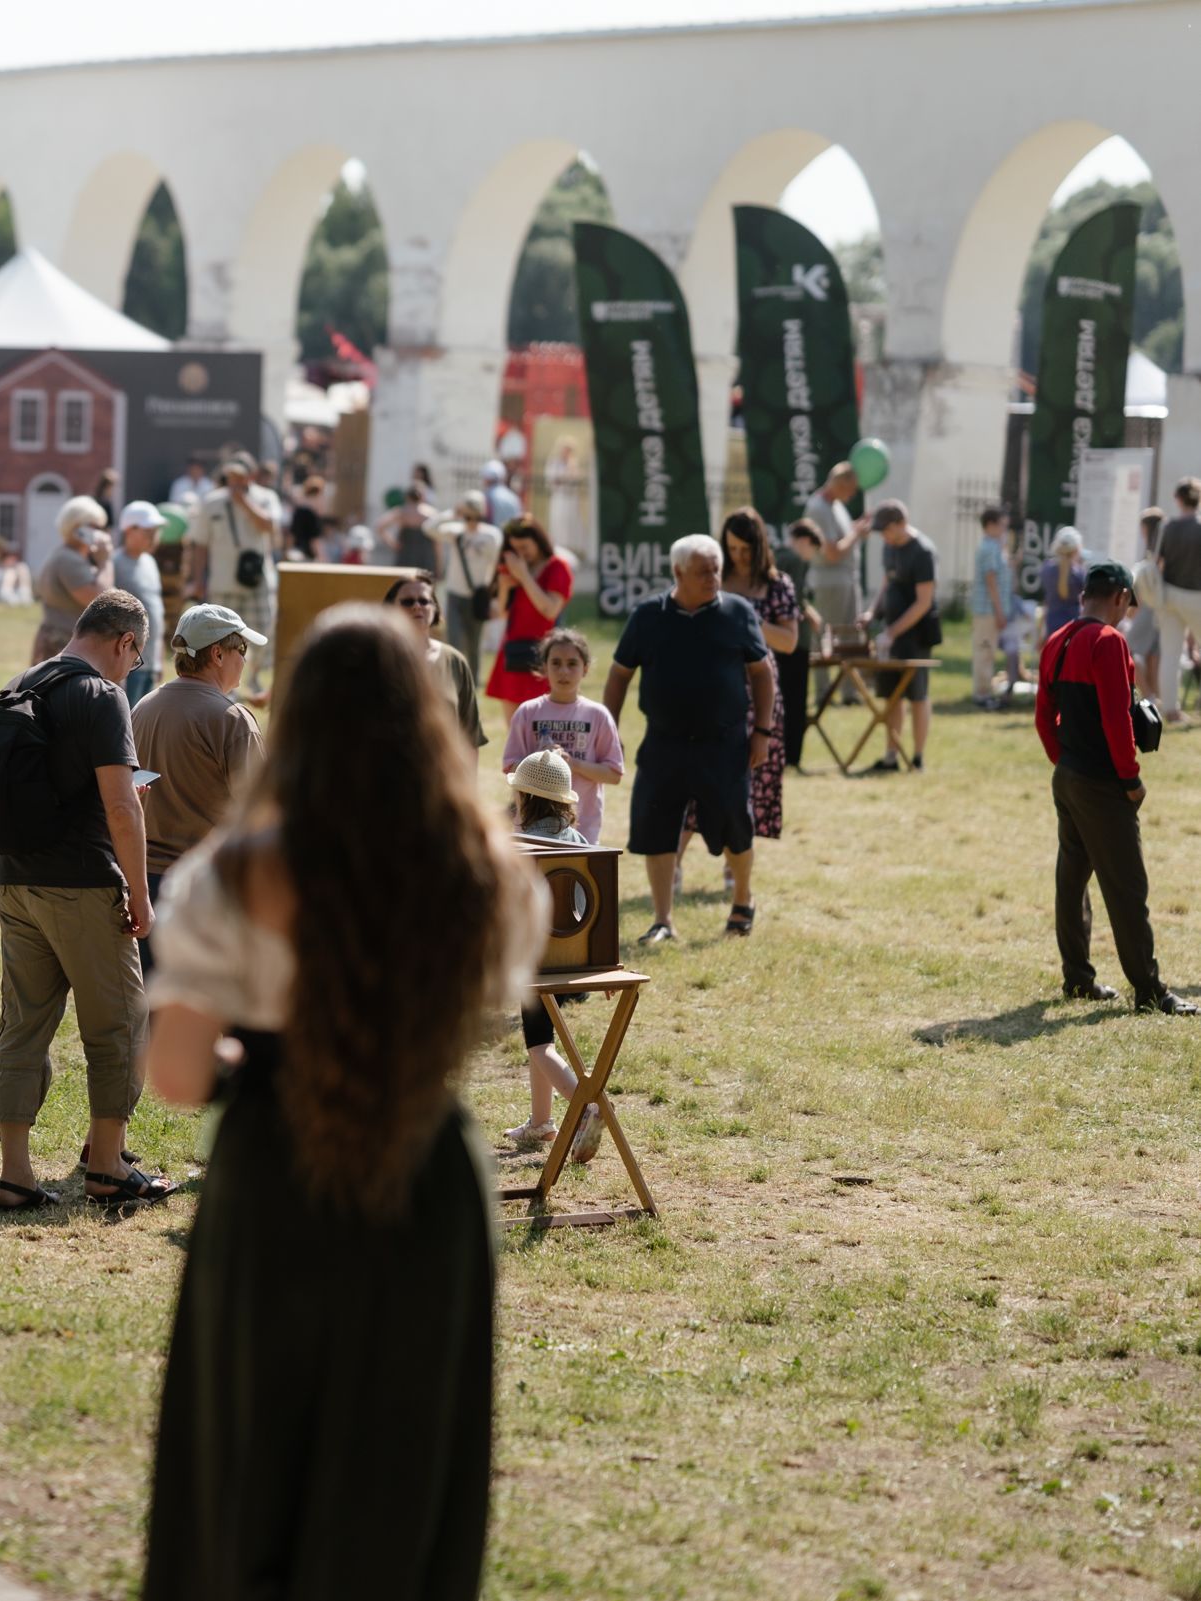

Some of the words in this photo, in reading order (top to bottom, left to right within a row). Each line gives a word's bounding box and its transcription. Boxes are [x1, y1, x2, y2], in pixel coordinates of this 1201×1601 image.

[630, 339, 663, 432] детям
[783, 318, 812, 411] детям
[1076, 318, 1096, 414] детям
[640, 435, 672, 526] Наука
[790, 414, 820, 505] Наука
